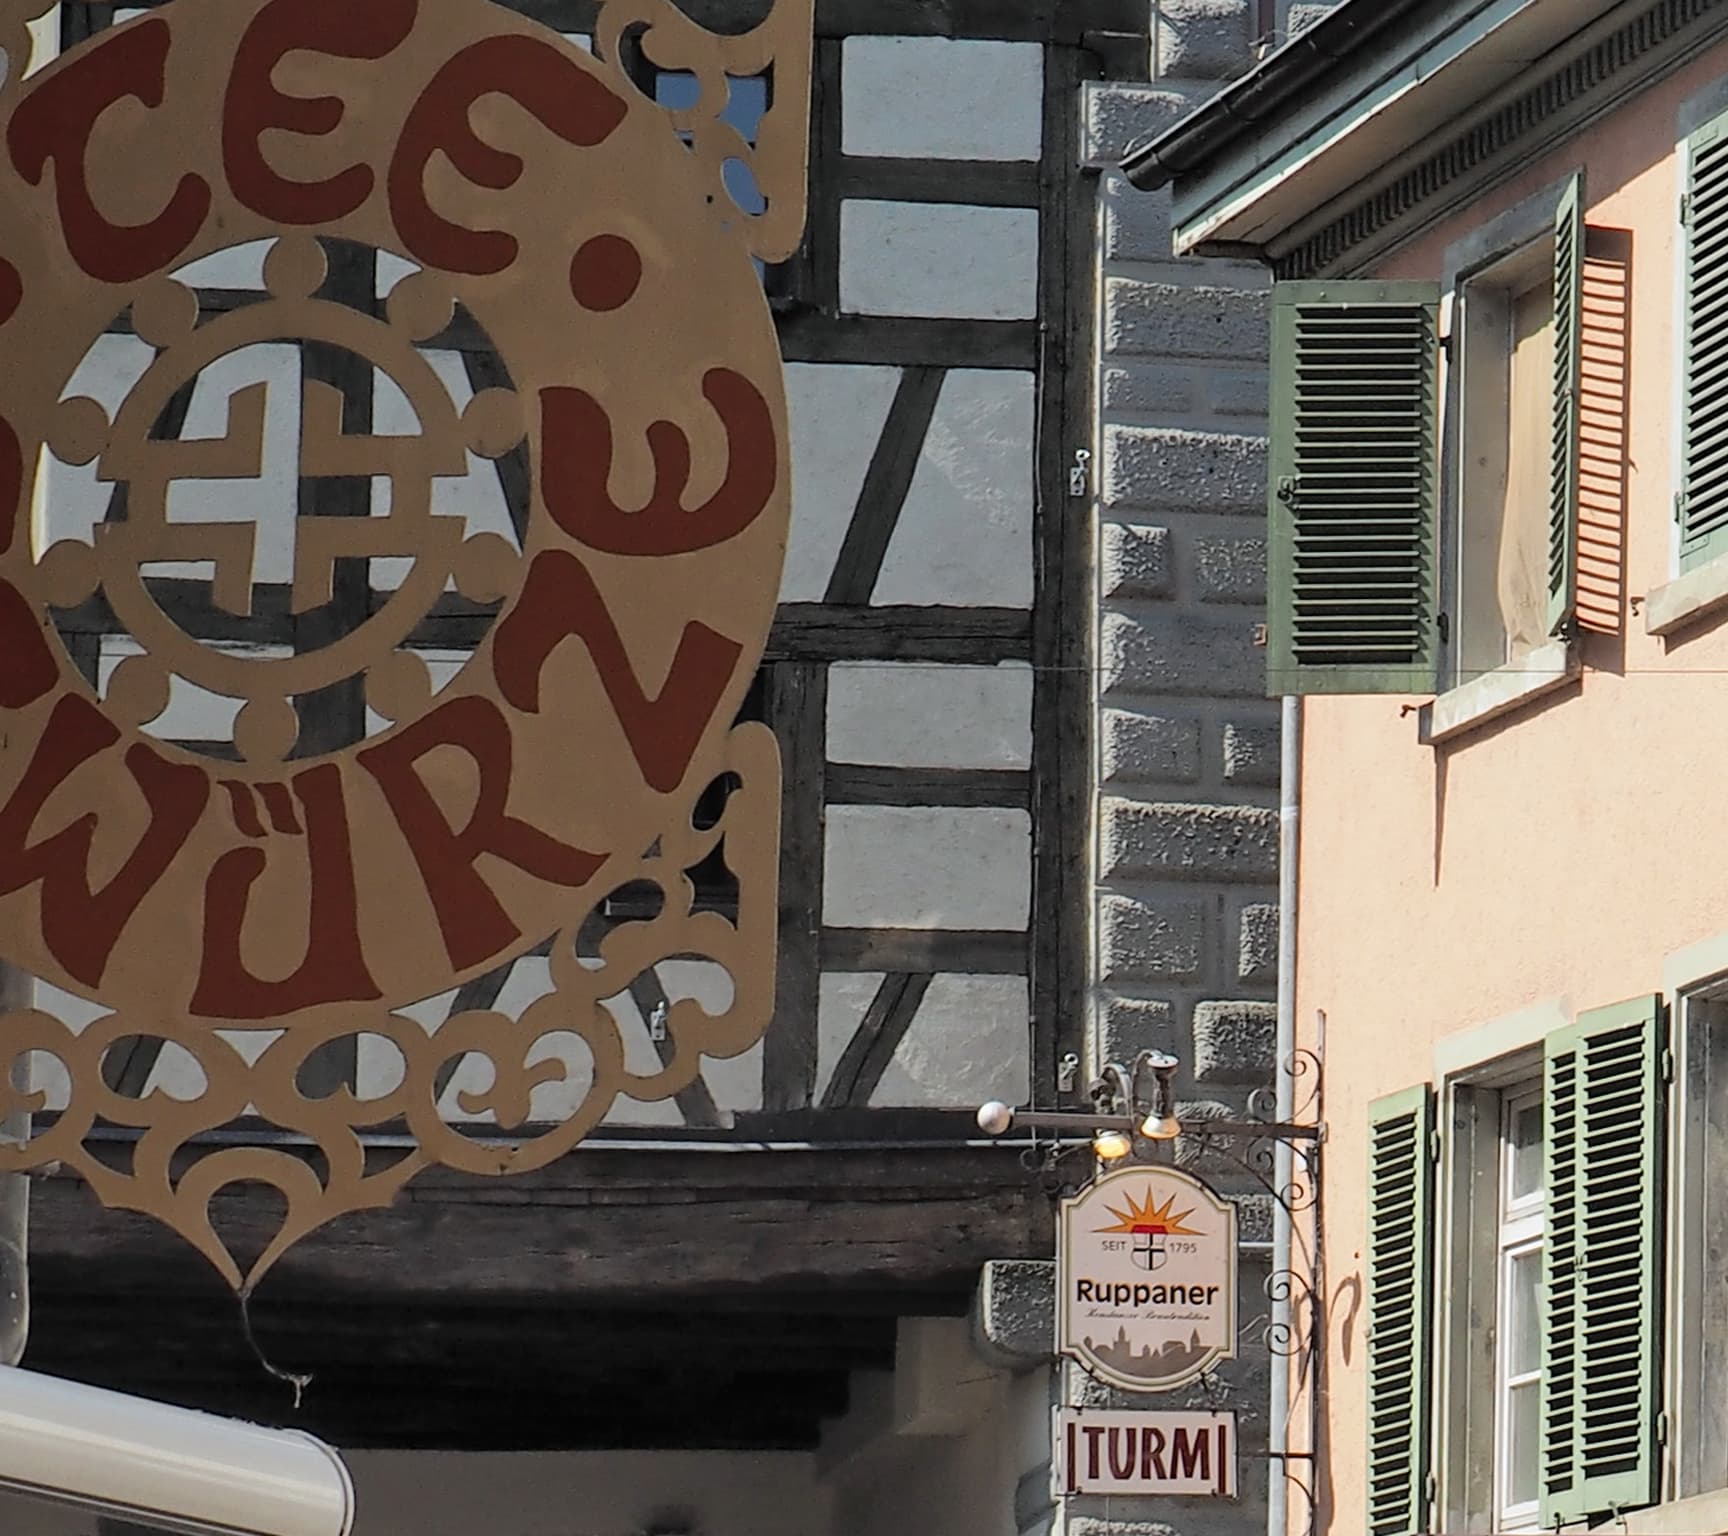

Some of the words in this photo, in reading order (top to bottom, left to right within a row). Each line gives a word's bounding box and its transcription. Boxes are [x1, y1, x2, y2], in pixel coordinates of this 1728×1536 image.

[1101, 1240, 1126, 1253] SEIT
[1169, 1242, 1197, 1254] 1795
[1076, 1279, 1220, 1308] Ruppaner
[1082, 1426, 1211, 1480] TURM
